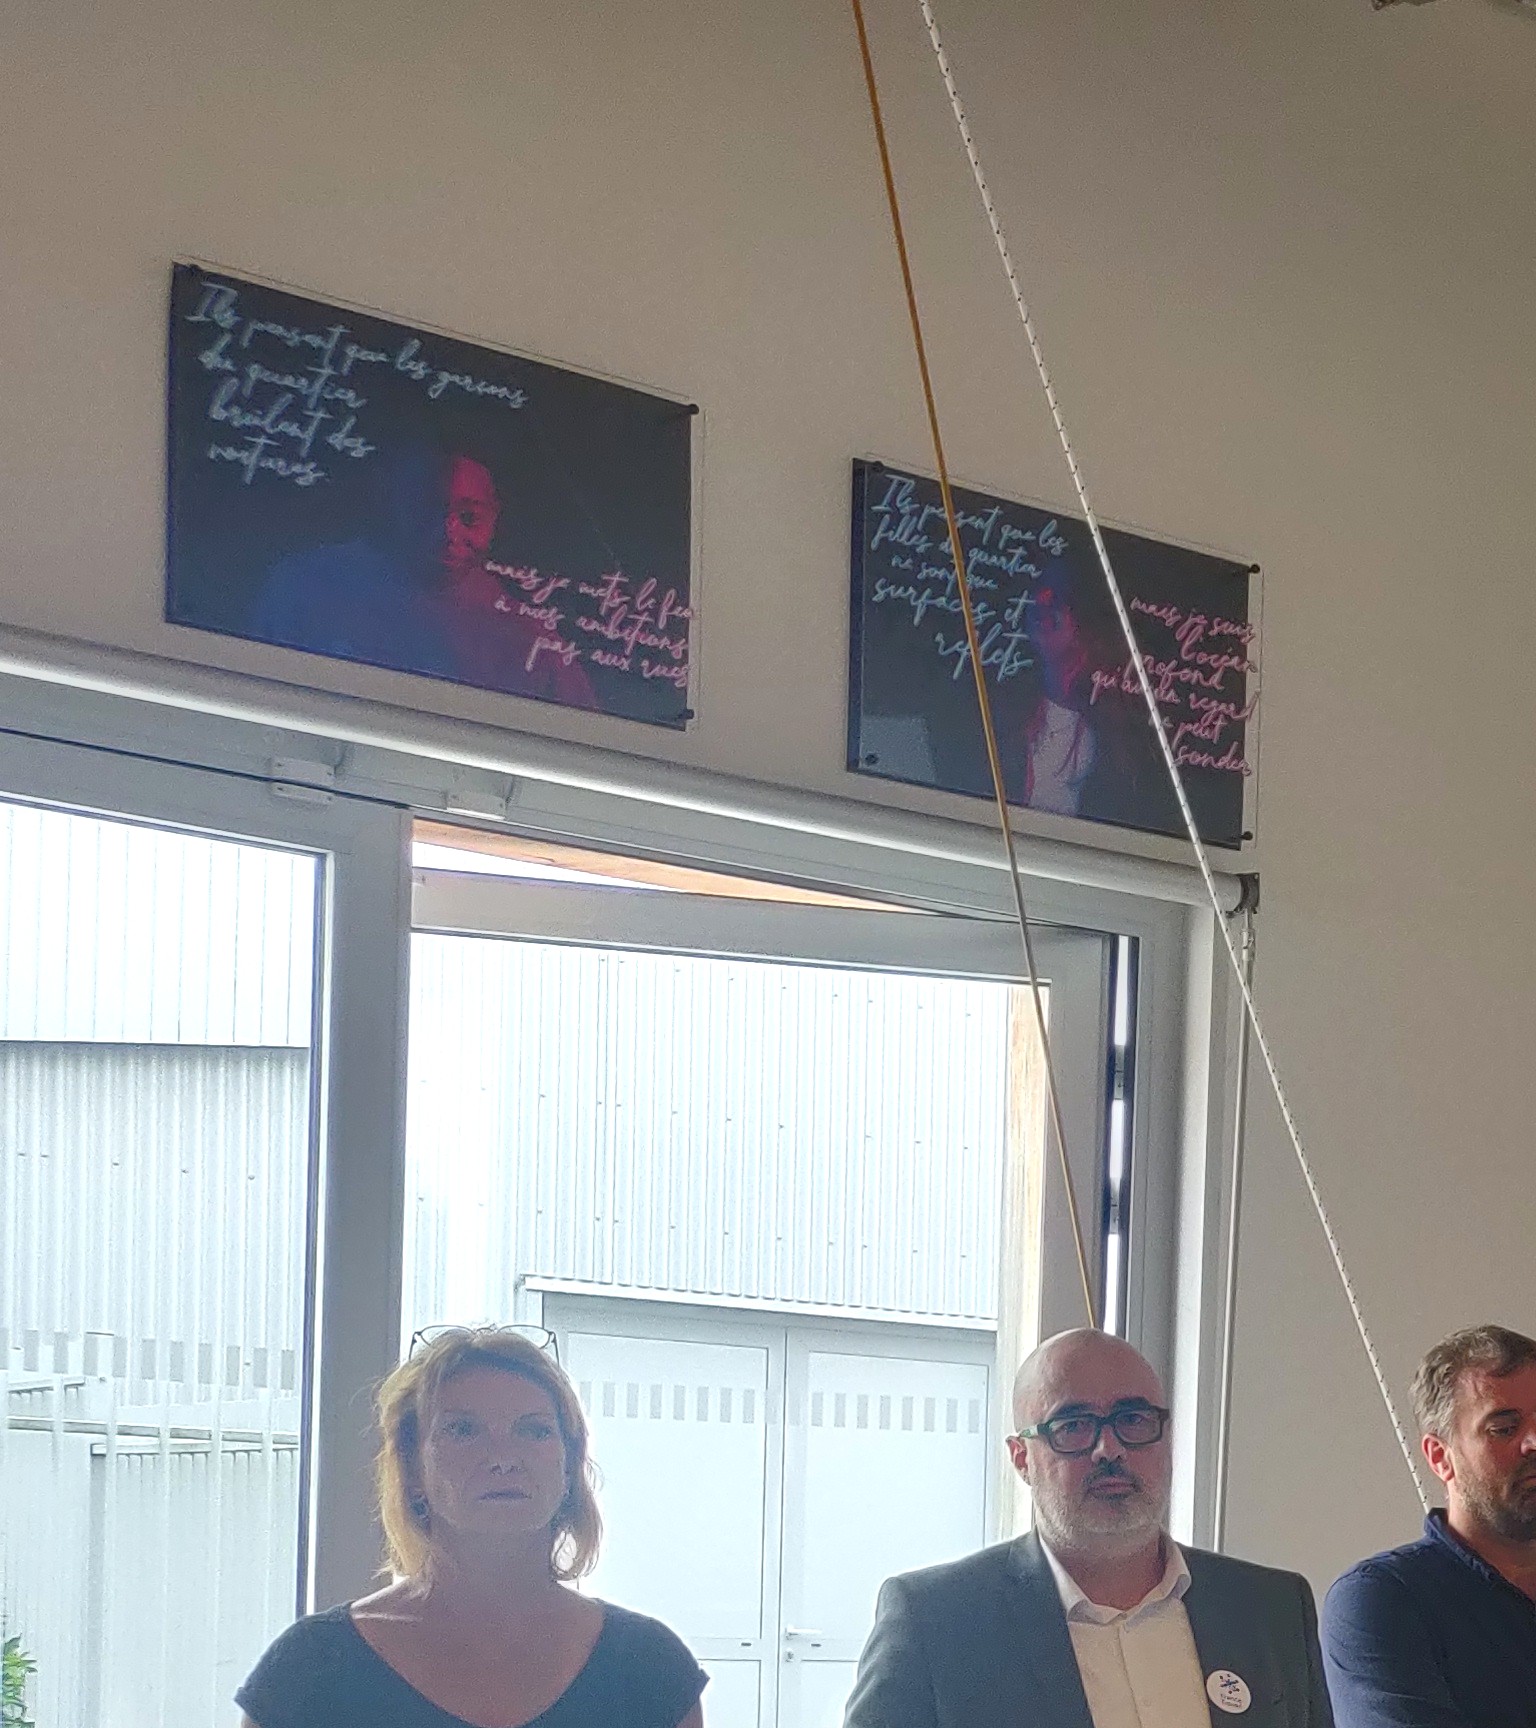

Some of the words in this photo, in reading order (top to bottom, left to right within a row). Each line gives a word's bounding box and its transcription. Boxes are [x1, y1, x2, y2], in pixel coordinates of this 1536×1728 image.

[870, 474, 920, 513] Ils
[635, 577, 656, 610] le
[1003, 589, 1036, 630] et
